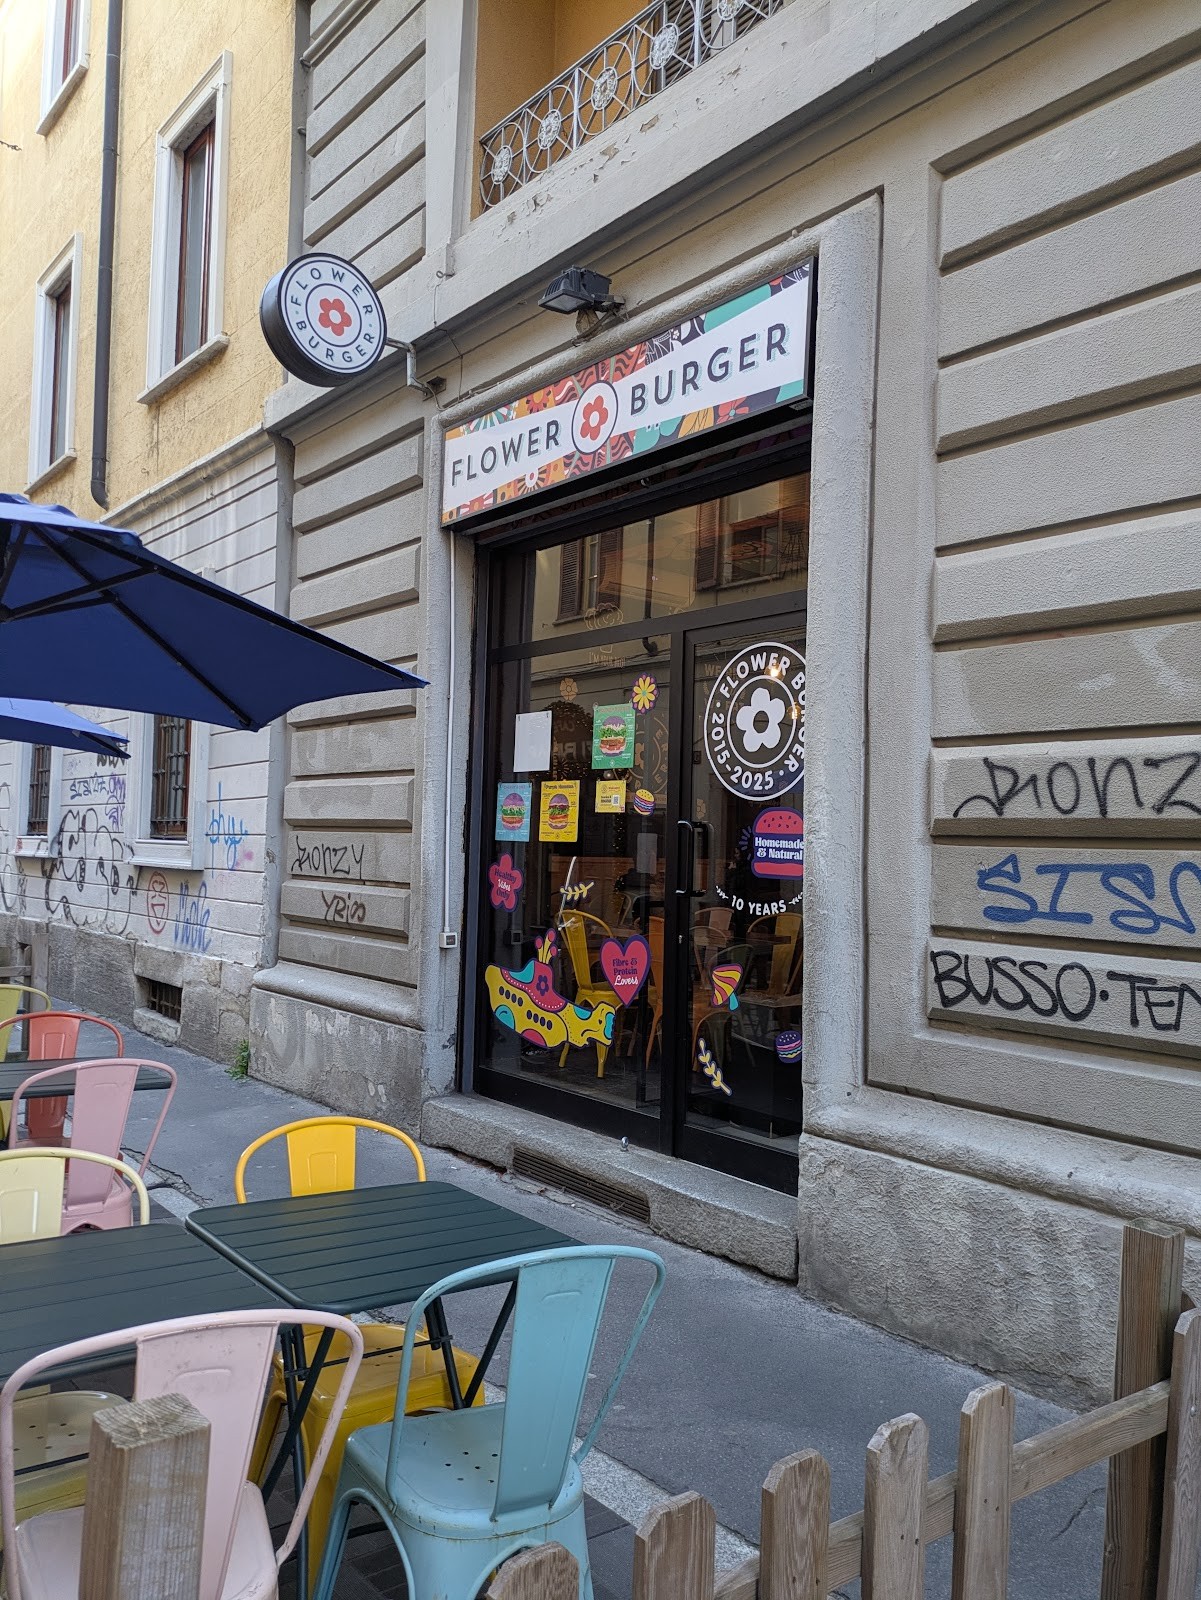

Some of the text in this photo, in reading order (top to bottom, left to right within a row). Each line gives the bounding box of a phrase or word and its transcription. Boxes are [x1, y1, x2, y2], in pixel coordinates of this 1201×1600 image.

[290, 267, 373, 315] FLOWER
[295, 320, 375, 363] BURGER
[451, 322, 788, 487] FLOWER BURGER
[719, 651, 791, 699] FLOWER
[711, 712, 774, 791] 2015-2025
[754, 836, 805, 850] Homemade
[756, 847, 803, 861] & Natural
[730, 894, 787, 916] 10 YEARS
[613, 966, 639, 976] Protein
